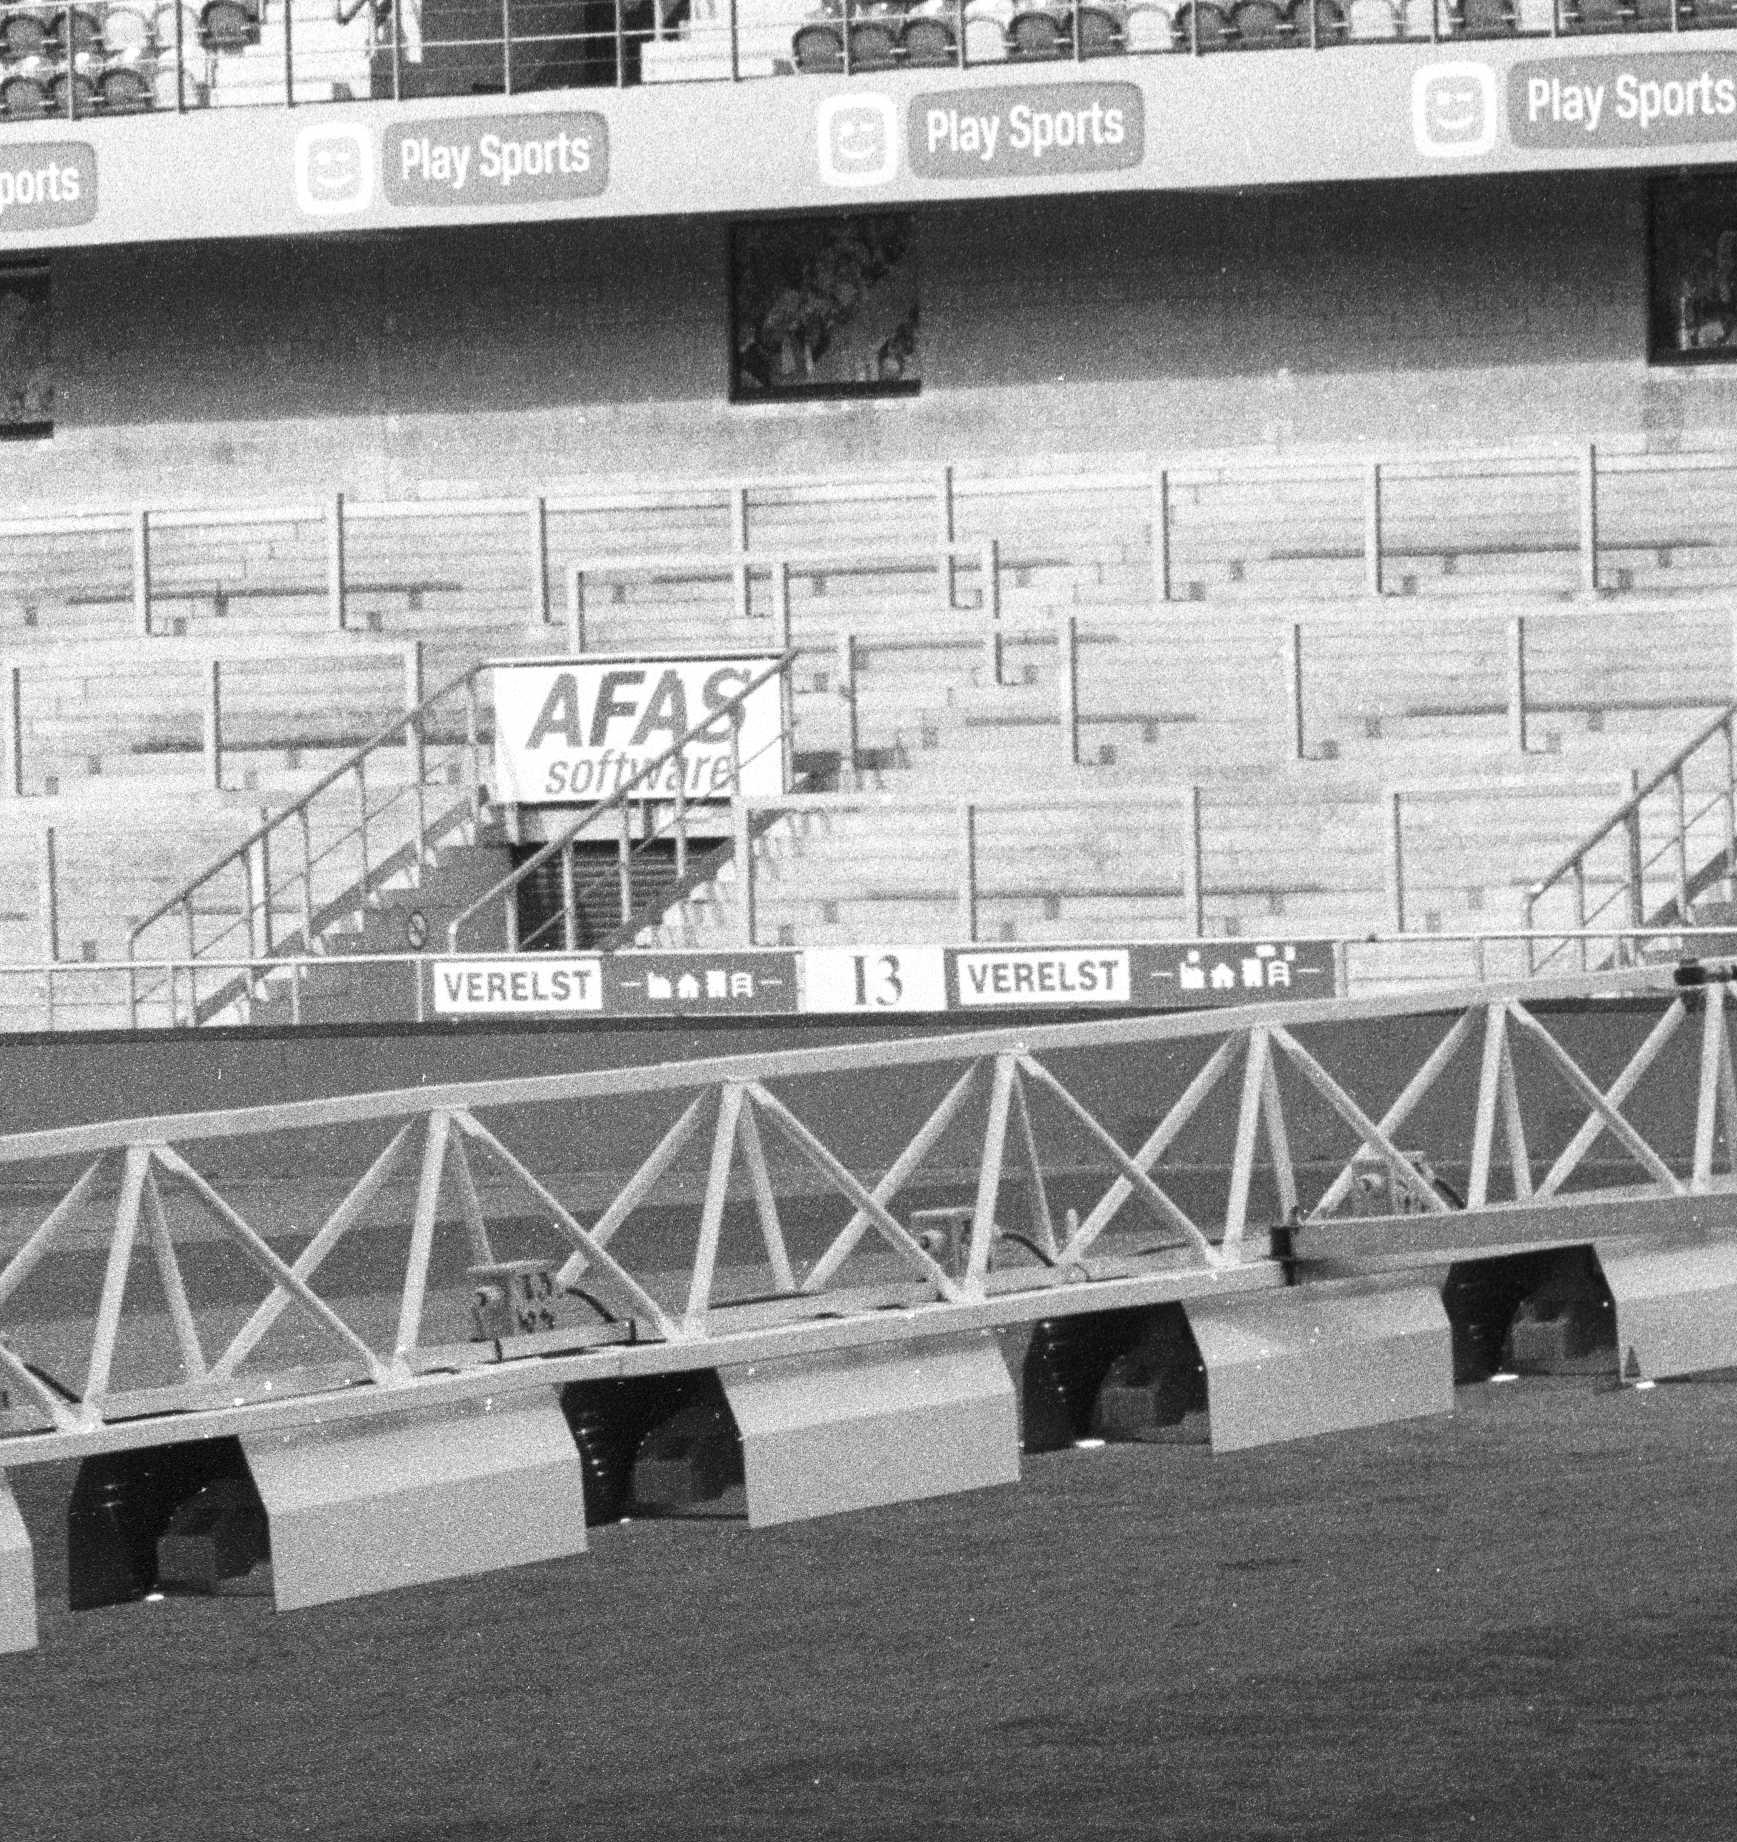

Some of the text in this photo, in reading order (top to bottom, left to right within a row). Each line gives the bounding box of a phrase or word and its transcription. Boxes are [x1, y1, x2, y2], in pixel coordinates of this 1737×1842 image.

[1528, 72, 1737, 131] Play Sports
[927, 102, 1124, 161] Play Sports
[401, 133, 590, 189] Play Sports
[525, 667, 752, 749] AFAS
[545, 748, 736, 795] software
[444, 970, 592, 1002] VERELST
[849, 953, 904, 1007] 13
[968, 959, 1120, 995] VERELST
